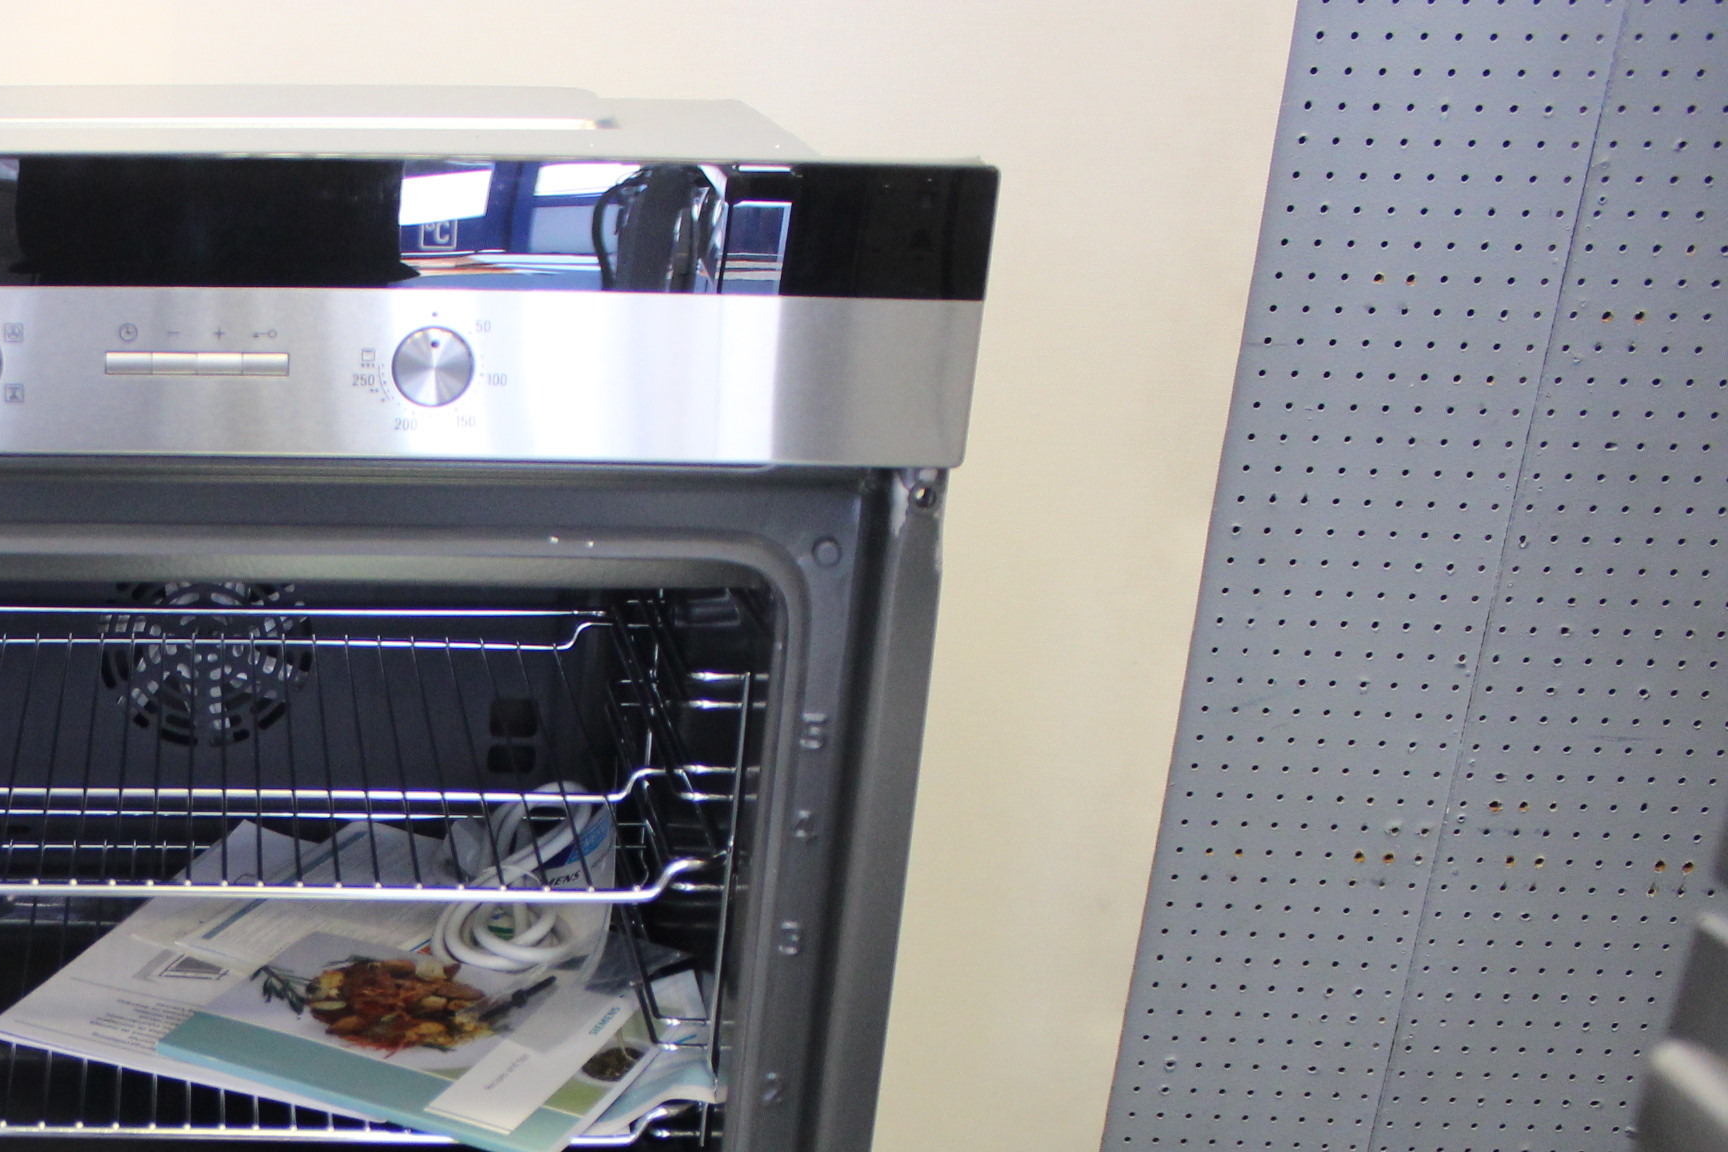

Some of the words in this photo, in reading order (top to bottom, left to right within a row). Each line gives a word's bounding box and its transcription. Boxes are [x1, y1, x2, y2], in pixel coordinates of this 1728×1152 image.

[475, 319, 491, 333] 50
[352, 373, 375, 387] 250
[487, 373, 507, 386] 100
[394, 417, 418, 431] 200
[456, 415, 476, 428] 150
[588, 1006, 621, 1036] SIEMENS
